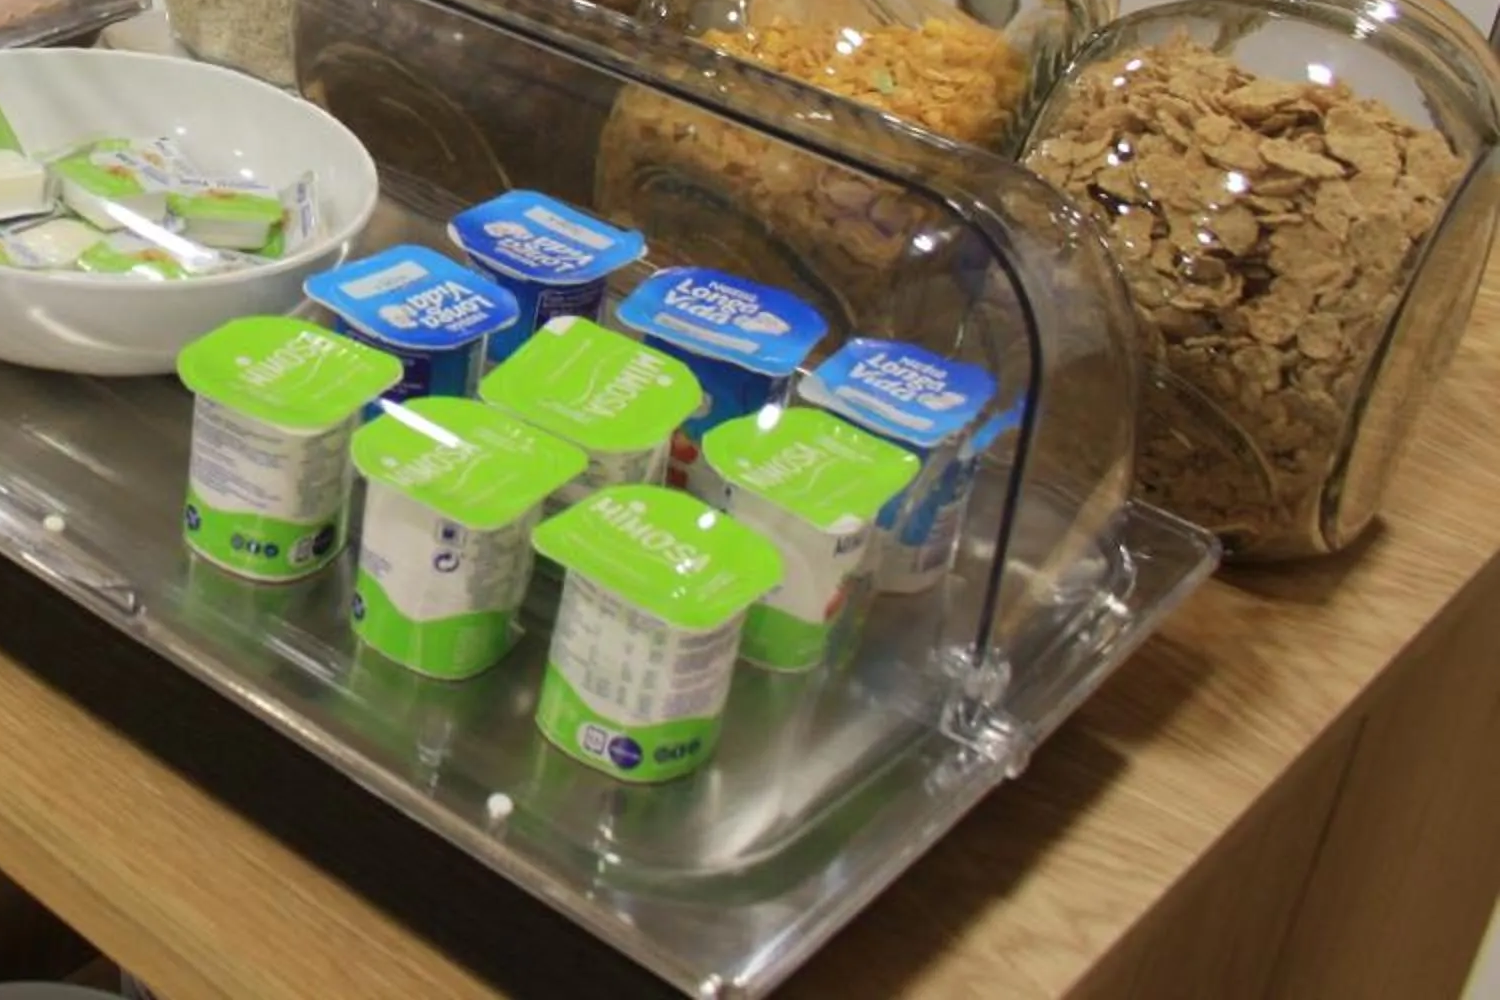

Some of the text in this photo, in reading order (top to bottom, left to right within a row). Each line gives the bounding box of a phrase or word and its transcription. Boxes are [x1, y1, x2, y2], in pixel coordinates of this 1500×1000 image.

[663, 289, 732, 325] Vida
[675, 277, 761, 315] Longa
[583, 350, 673, 418] MIMOSA
[849, 362, 919, 402] Vida
[737, 441, 828, 489] MIMOSA
[589, 497, 711, 574] MIMOSA
